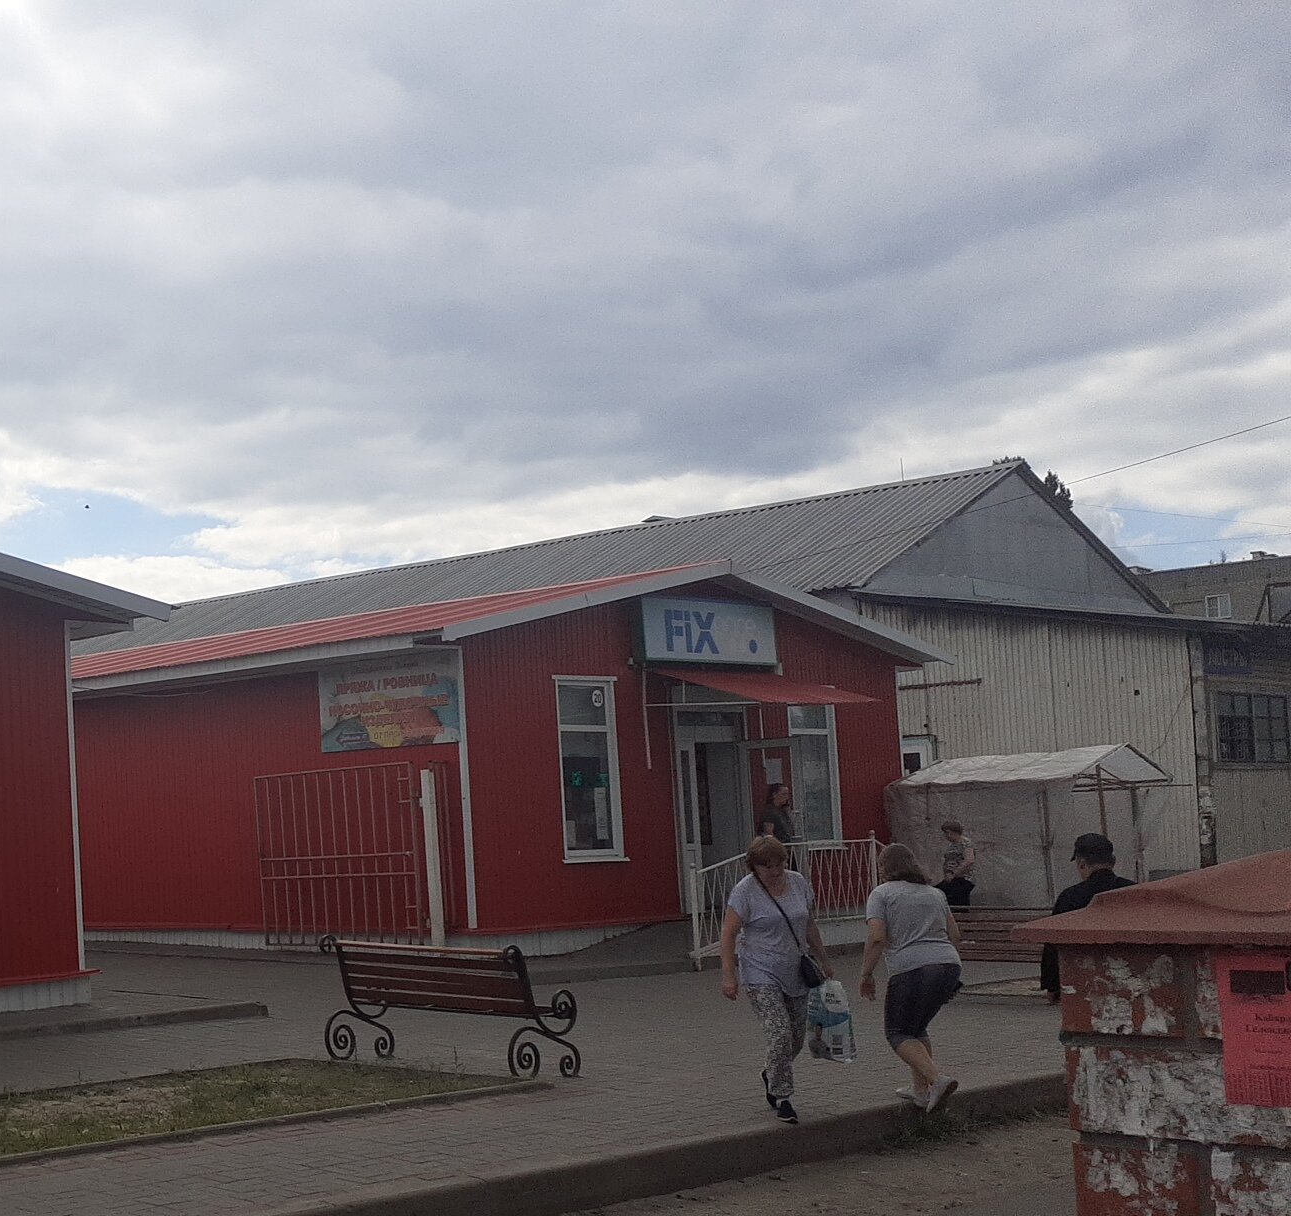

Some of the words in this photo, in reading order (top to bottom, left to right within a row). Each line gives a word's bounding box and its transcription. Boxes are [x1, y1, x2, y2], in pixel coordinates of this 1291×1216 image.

[335, 680, 376, 695] ПРЯЖА
[383, 673, 439, 690] РОВНИЦА
[594, 693, 603, 704] 20
